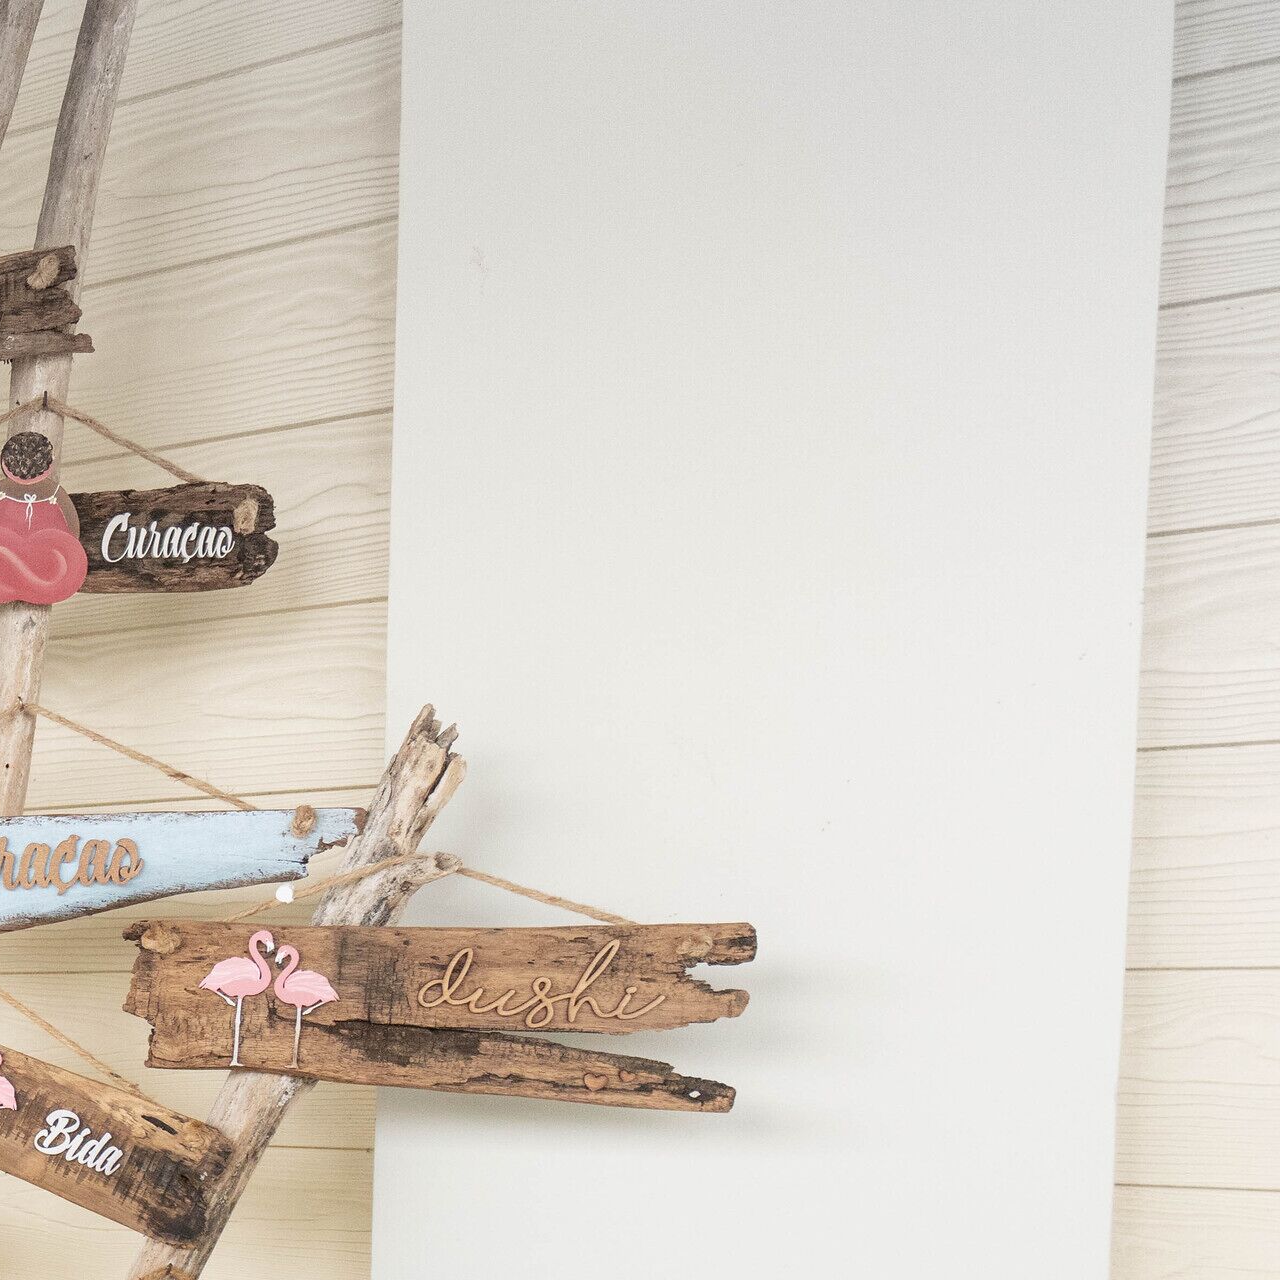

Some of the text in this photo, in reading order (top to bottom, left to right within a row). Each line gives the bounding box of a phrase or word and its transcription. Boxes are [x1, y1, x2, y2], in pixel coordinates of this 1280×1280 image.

[100, 513, 235, 565] Curaçao
[416, 938, 666, 1028] dushi
[33, 1108, 124, 1176] Bida
